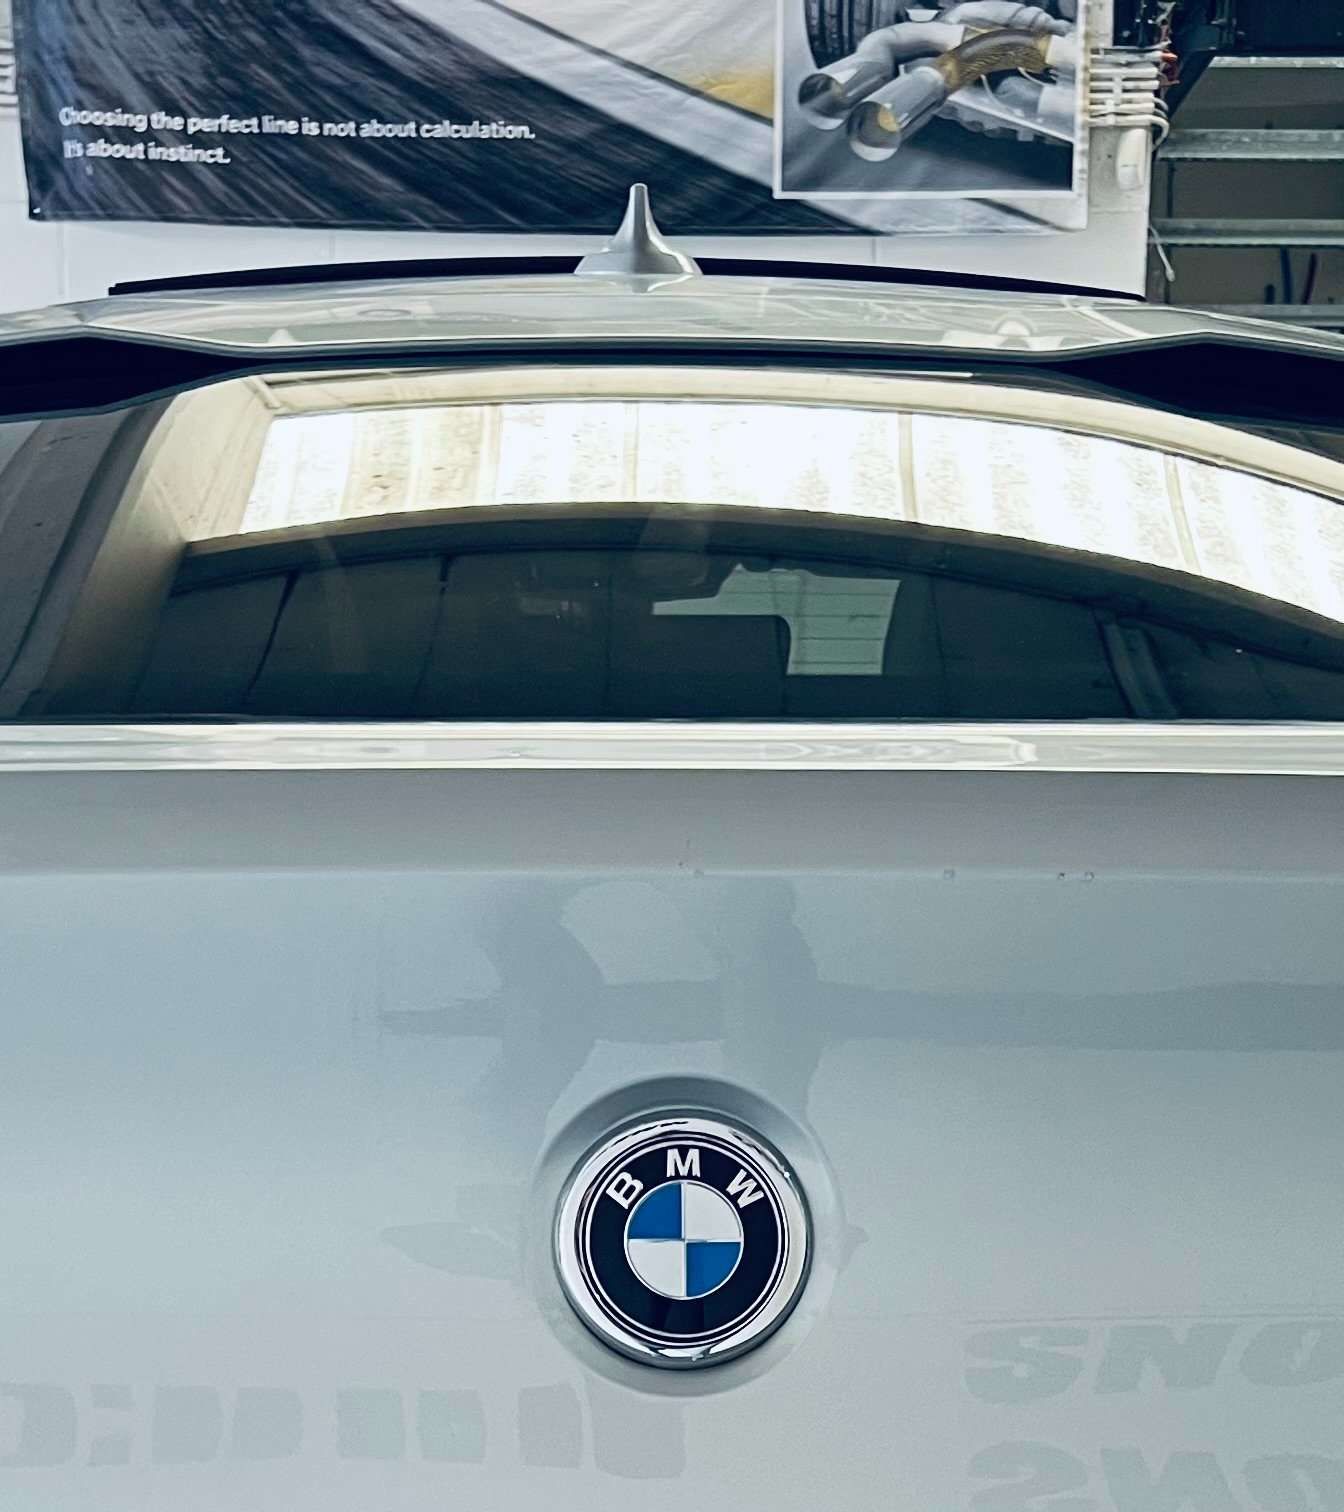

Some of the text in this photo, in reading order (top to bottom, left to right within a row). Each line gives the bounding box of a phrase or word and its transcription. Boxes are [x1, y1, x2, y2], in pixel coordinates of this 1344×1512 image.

[58, 107, 535, 139] Choosing the perfect line is not about calculation.
[85, 139, 146, 159] about
[147, 142, 231, 164] instinct.
[606, 1148, 765, 1209] BMW
